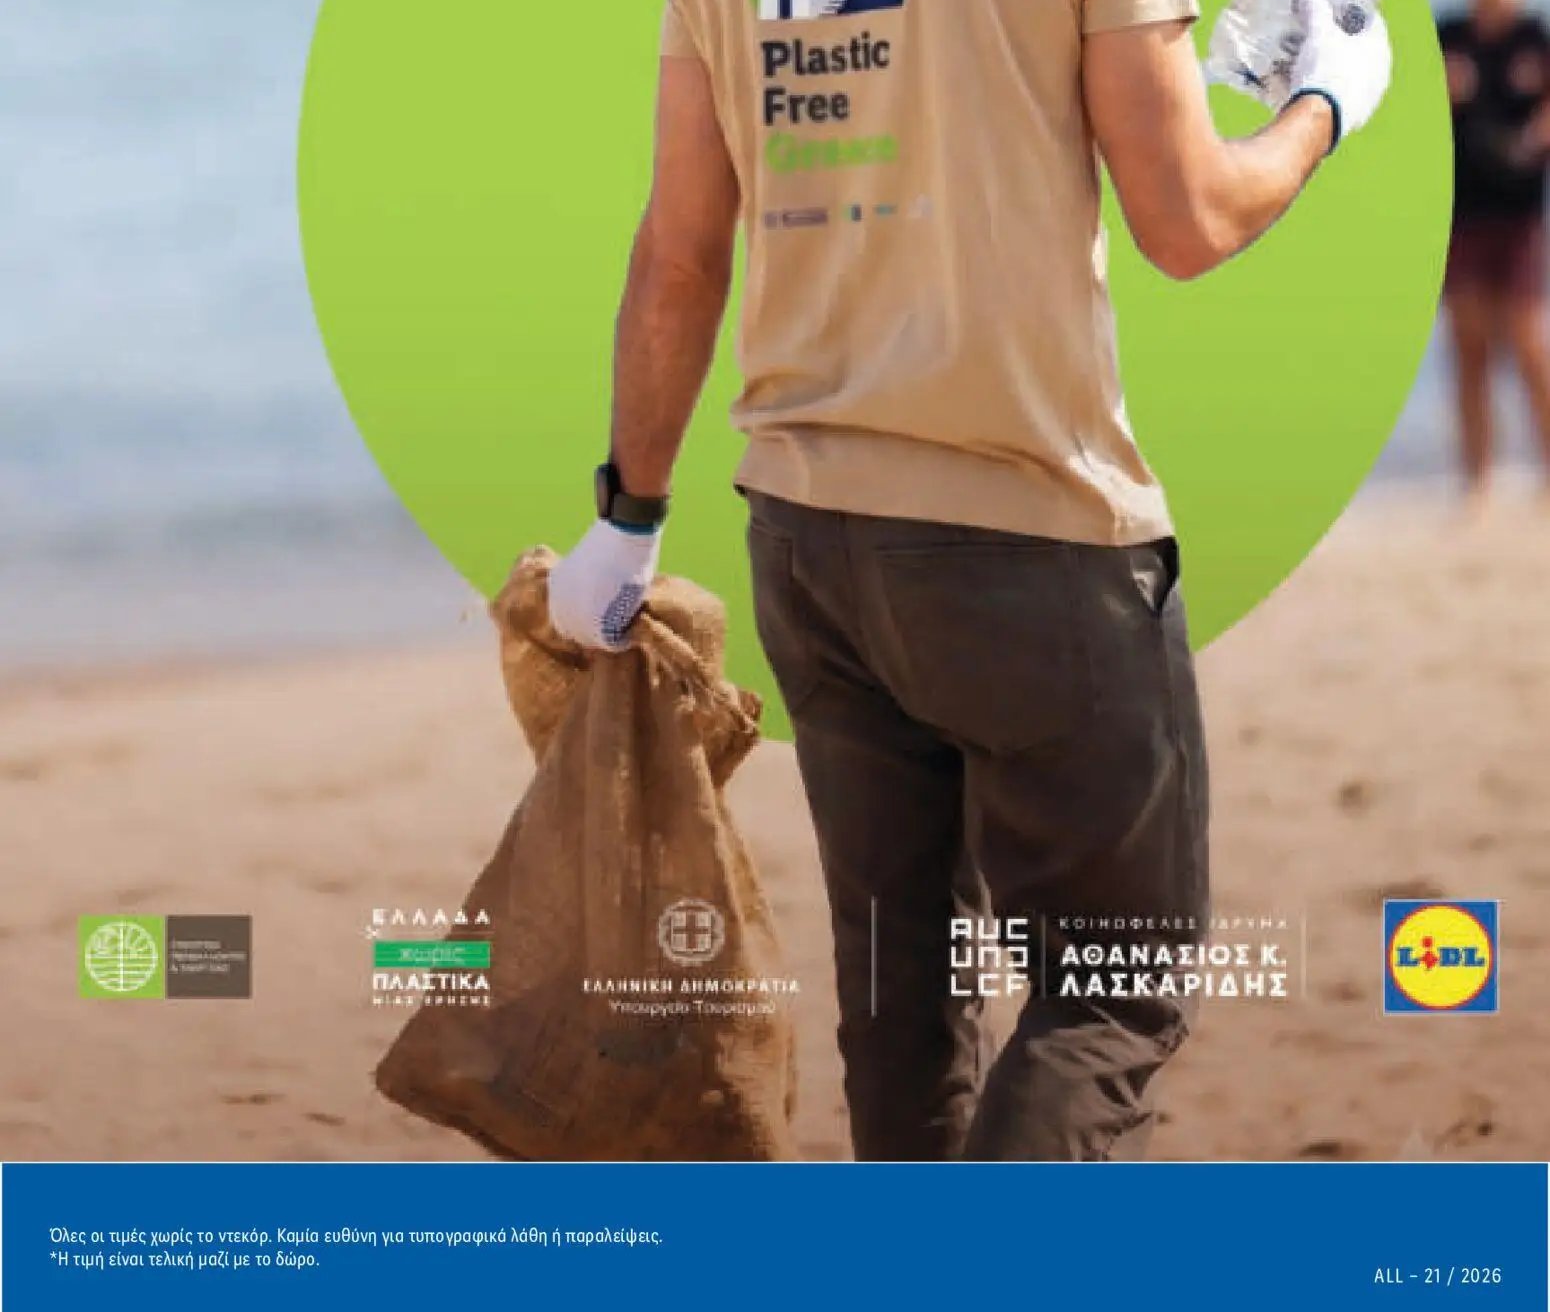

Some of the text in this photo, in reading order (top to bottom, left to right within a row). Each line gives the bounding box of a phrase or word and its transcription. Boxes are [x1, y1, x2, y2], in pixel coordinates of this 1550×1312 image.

[761, 31, 891, 77] Plastic
[763, 87, 850, 126] Free
[372, 908, 492, 926] ΕΛΛΑΔΑ
[1060, 944, 1287, 967] ΑΘΑΝΑΣΙΟΣ Κ.
[372, 972, 491, 990] ΠΛΑΣΤΙΚΑ
[583, 977, 801, 993] ΕΛΛΗΝΙΚΗ ΔΗΜΟΚΡΑΤΙΑ
[1060, 973, 1288, 997] ΛΑΣΚΑΡΙΔΗΣ
[49, 1226, 663, 1248] Όλες οι τιμές χωρίς το ντεκόρ. Καμία ευθύνη για τυπογραφικά λάθη ή παραλείψεις.
[72, 1250, 104, 1271] τιμή
[108, 1251, 145, 1267] είναι
[148, 1250, 194, 1270] τελική
[198, 1250, 230, 1270] μαζί
[233, 1254, 250, 1270] με
[254, 1254, 271, 1266] το
[275, 1250, 320, 1270] δώρο.
[1374, 1267, 1404, 1284] ALL
[1424, 1267, 1440, 1284] 21
[1461, 1267, 1502, 1284] 2026
